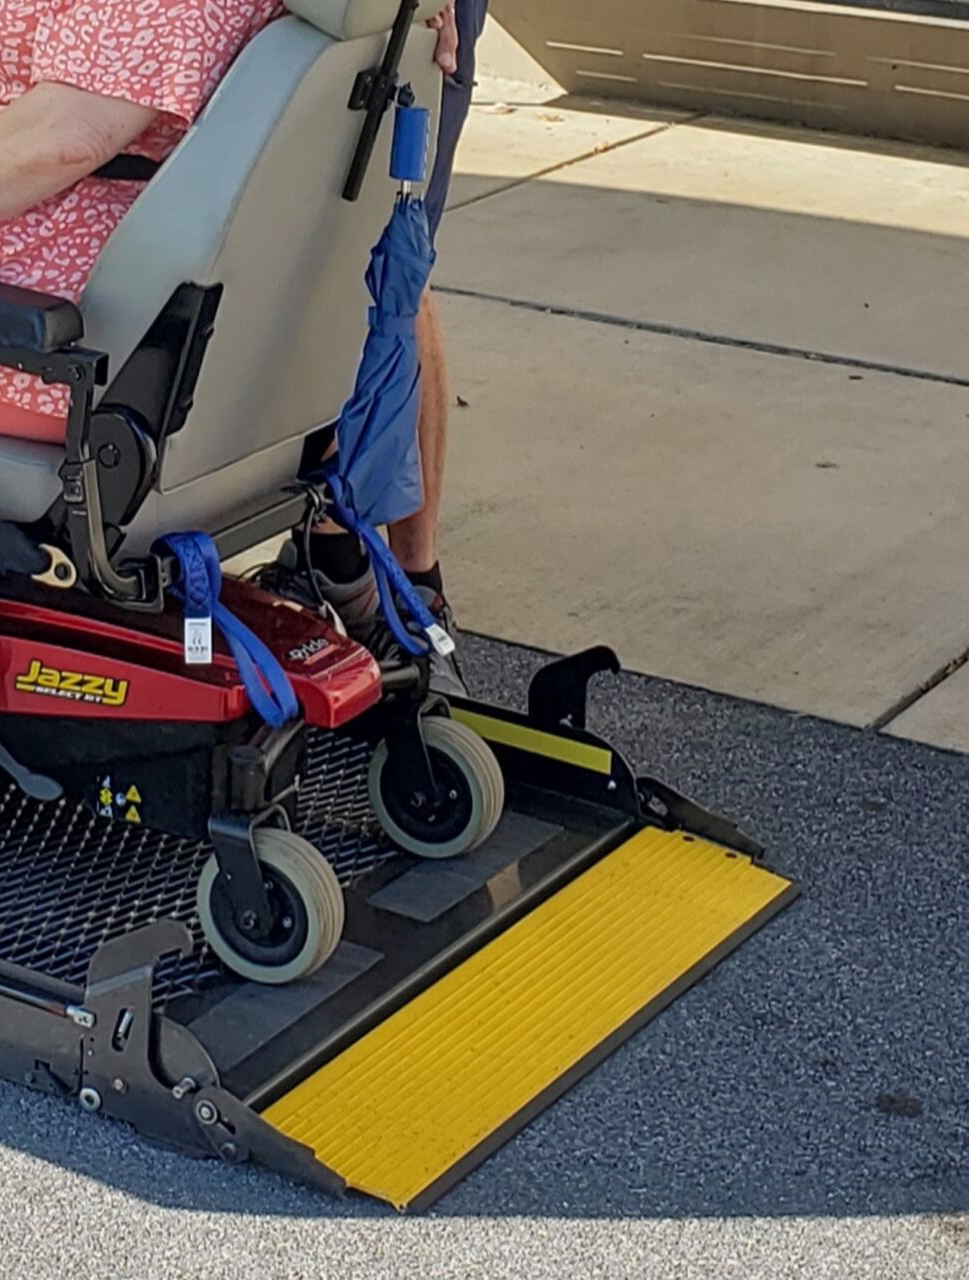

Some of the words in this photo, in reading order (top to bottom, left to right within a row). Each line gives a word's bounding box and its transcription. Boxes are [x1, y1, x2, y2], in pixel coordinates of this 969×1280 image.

[288, 638, 329, 661] Pride
[16, 660, 128, 705] Jazzy
[34, 685, 83, 701] SELECT
